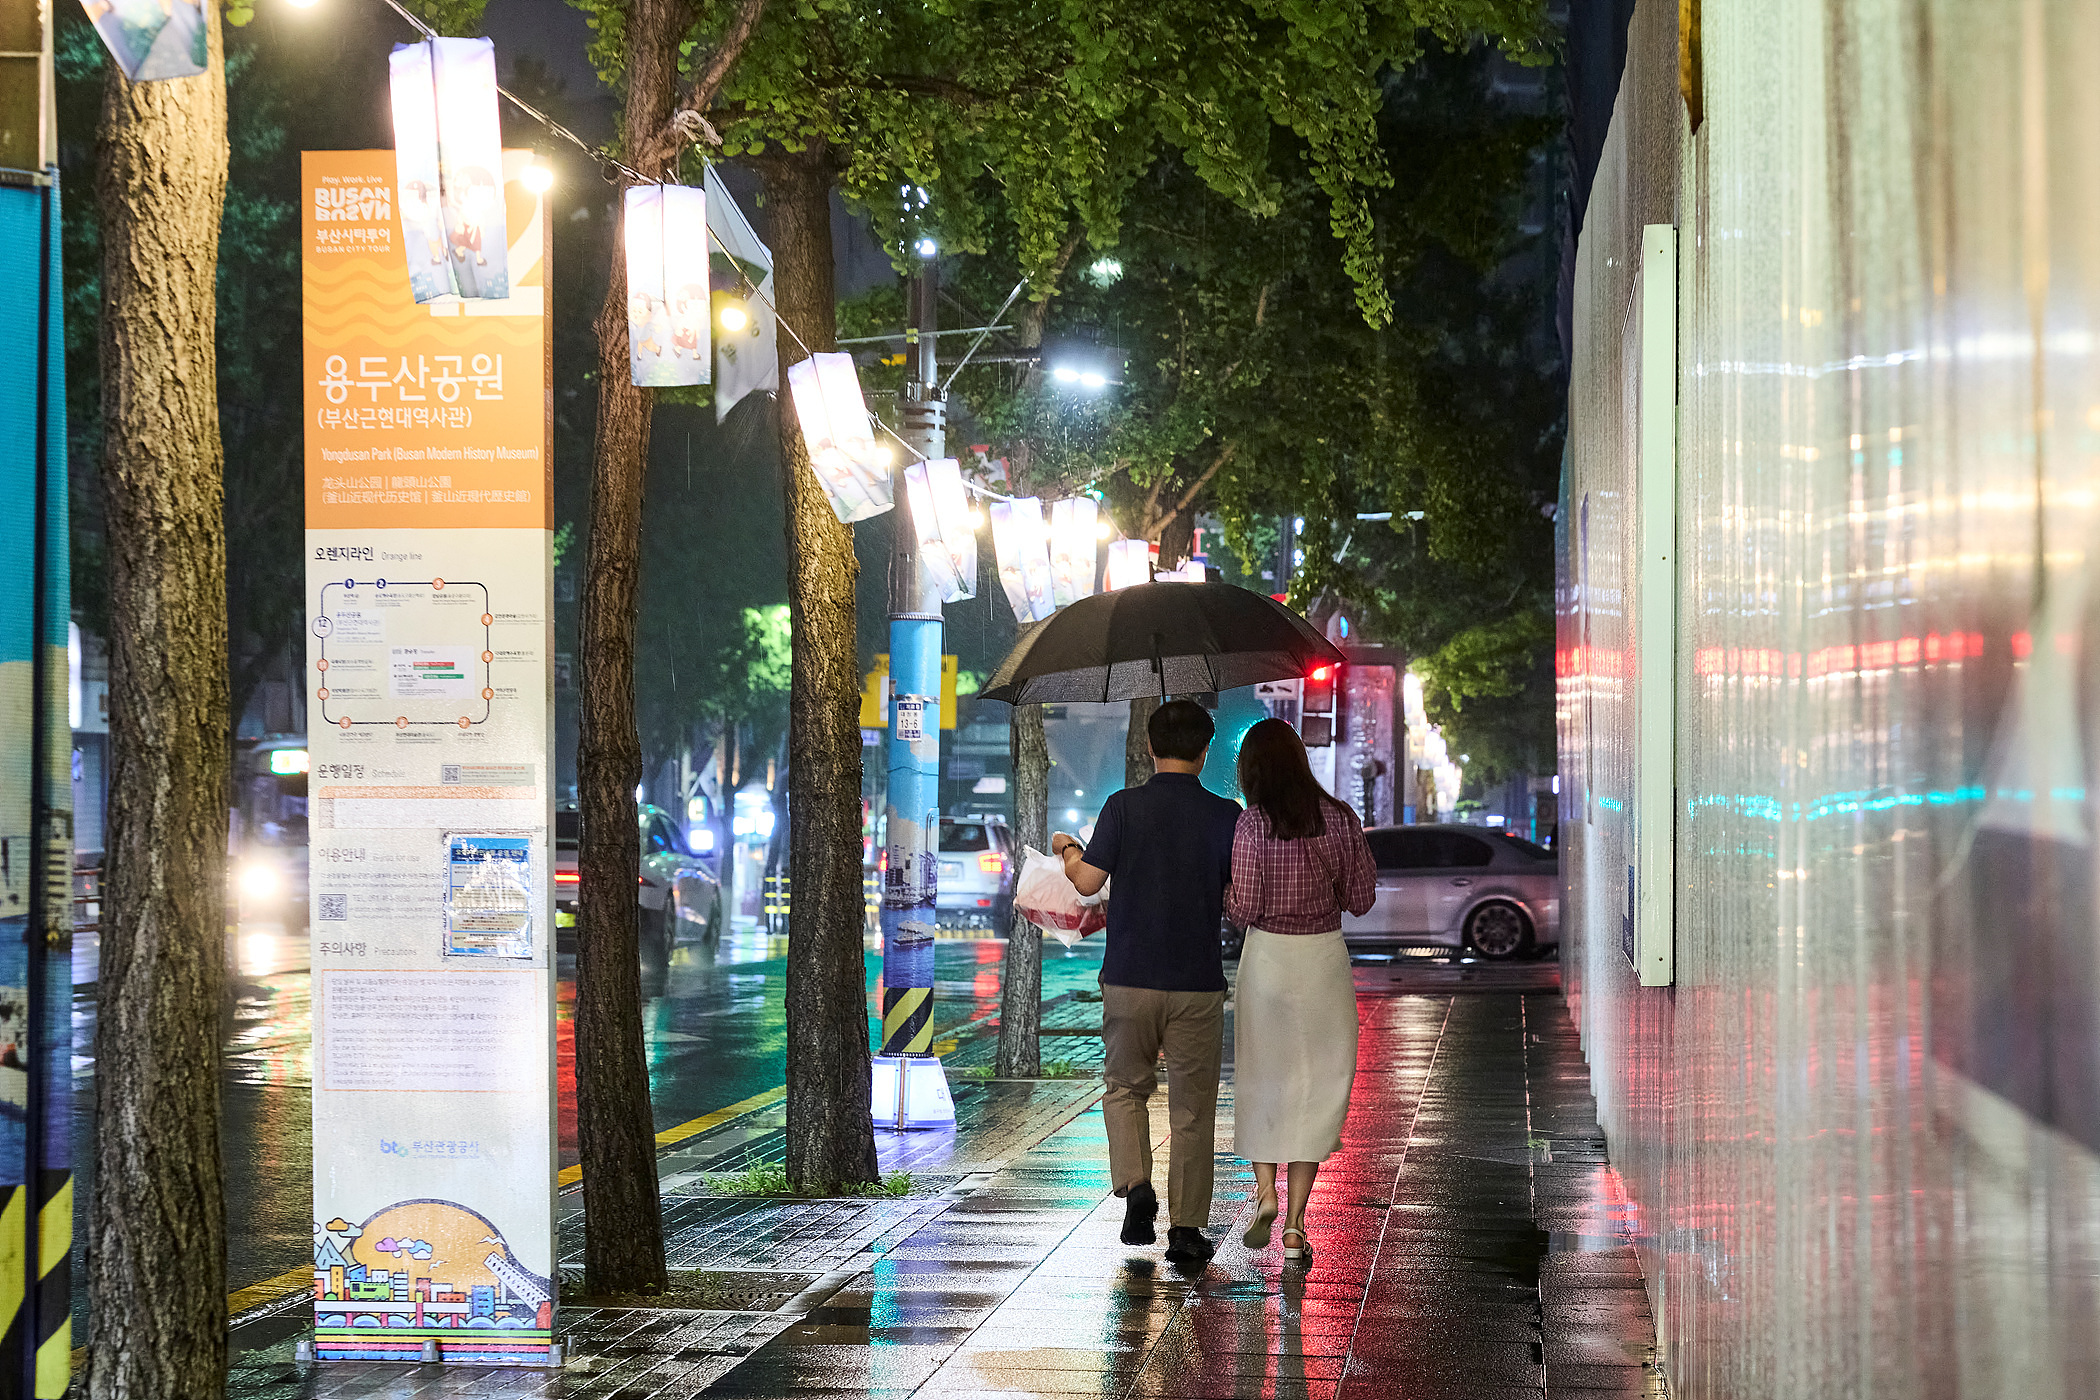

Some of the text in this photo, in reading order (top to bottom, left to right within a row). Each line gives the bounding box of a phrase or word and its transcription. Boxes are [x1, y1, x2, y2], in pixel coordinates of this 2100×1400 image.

[315, 187, 391, 209] BUSAN
[316, 228, 391, 244] 부산시티투어
[316, 245, 391, 253] BUSAN CITY TOUR
[318, 353, 504, 404] 용두산공원
[317, 406, 473, 430] (부산근현대역사관)
[321, 445, 539, 464] Yongdusan Park (Busan Modern History Museum)
[315, 547, 374, 562] 오렌지라인
[381, 551, 423, 563] Orange line
[900, 718, 918, 728] 13-6
[317, 764, 365, 779] 운행일정
[318, 847, 366, 863] 이용안내
[319, 942, 367, 957] 주의사항
[412, 1140, 479, 1154] 부산관광공사
